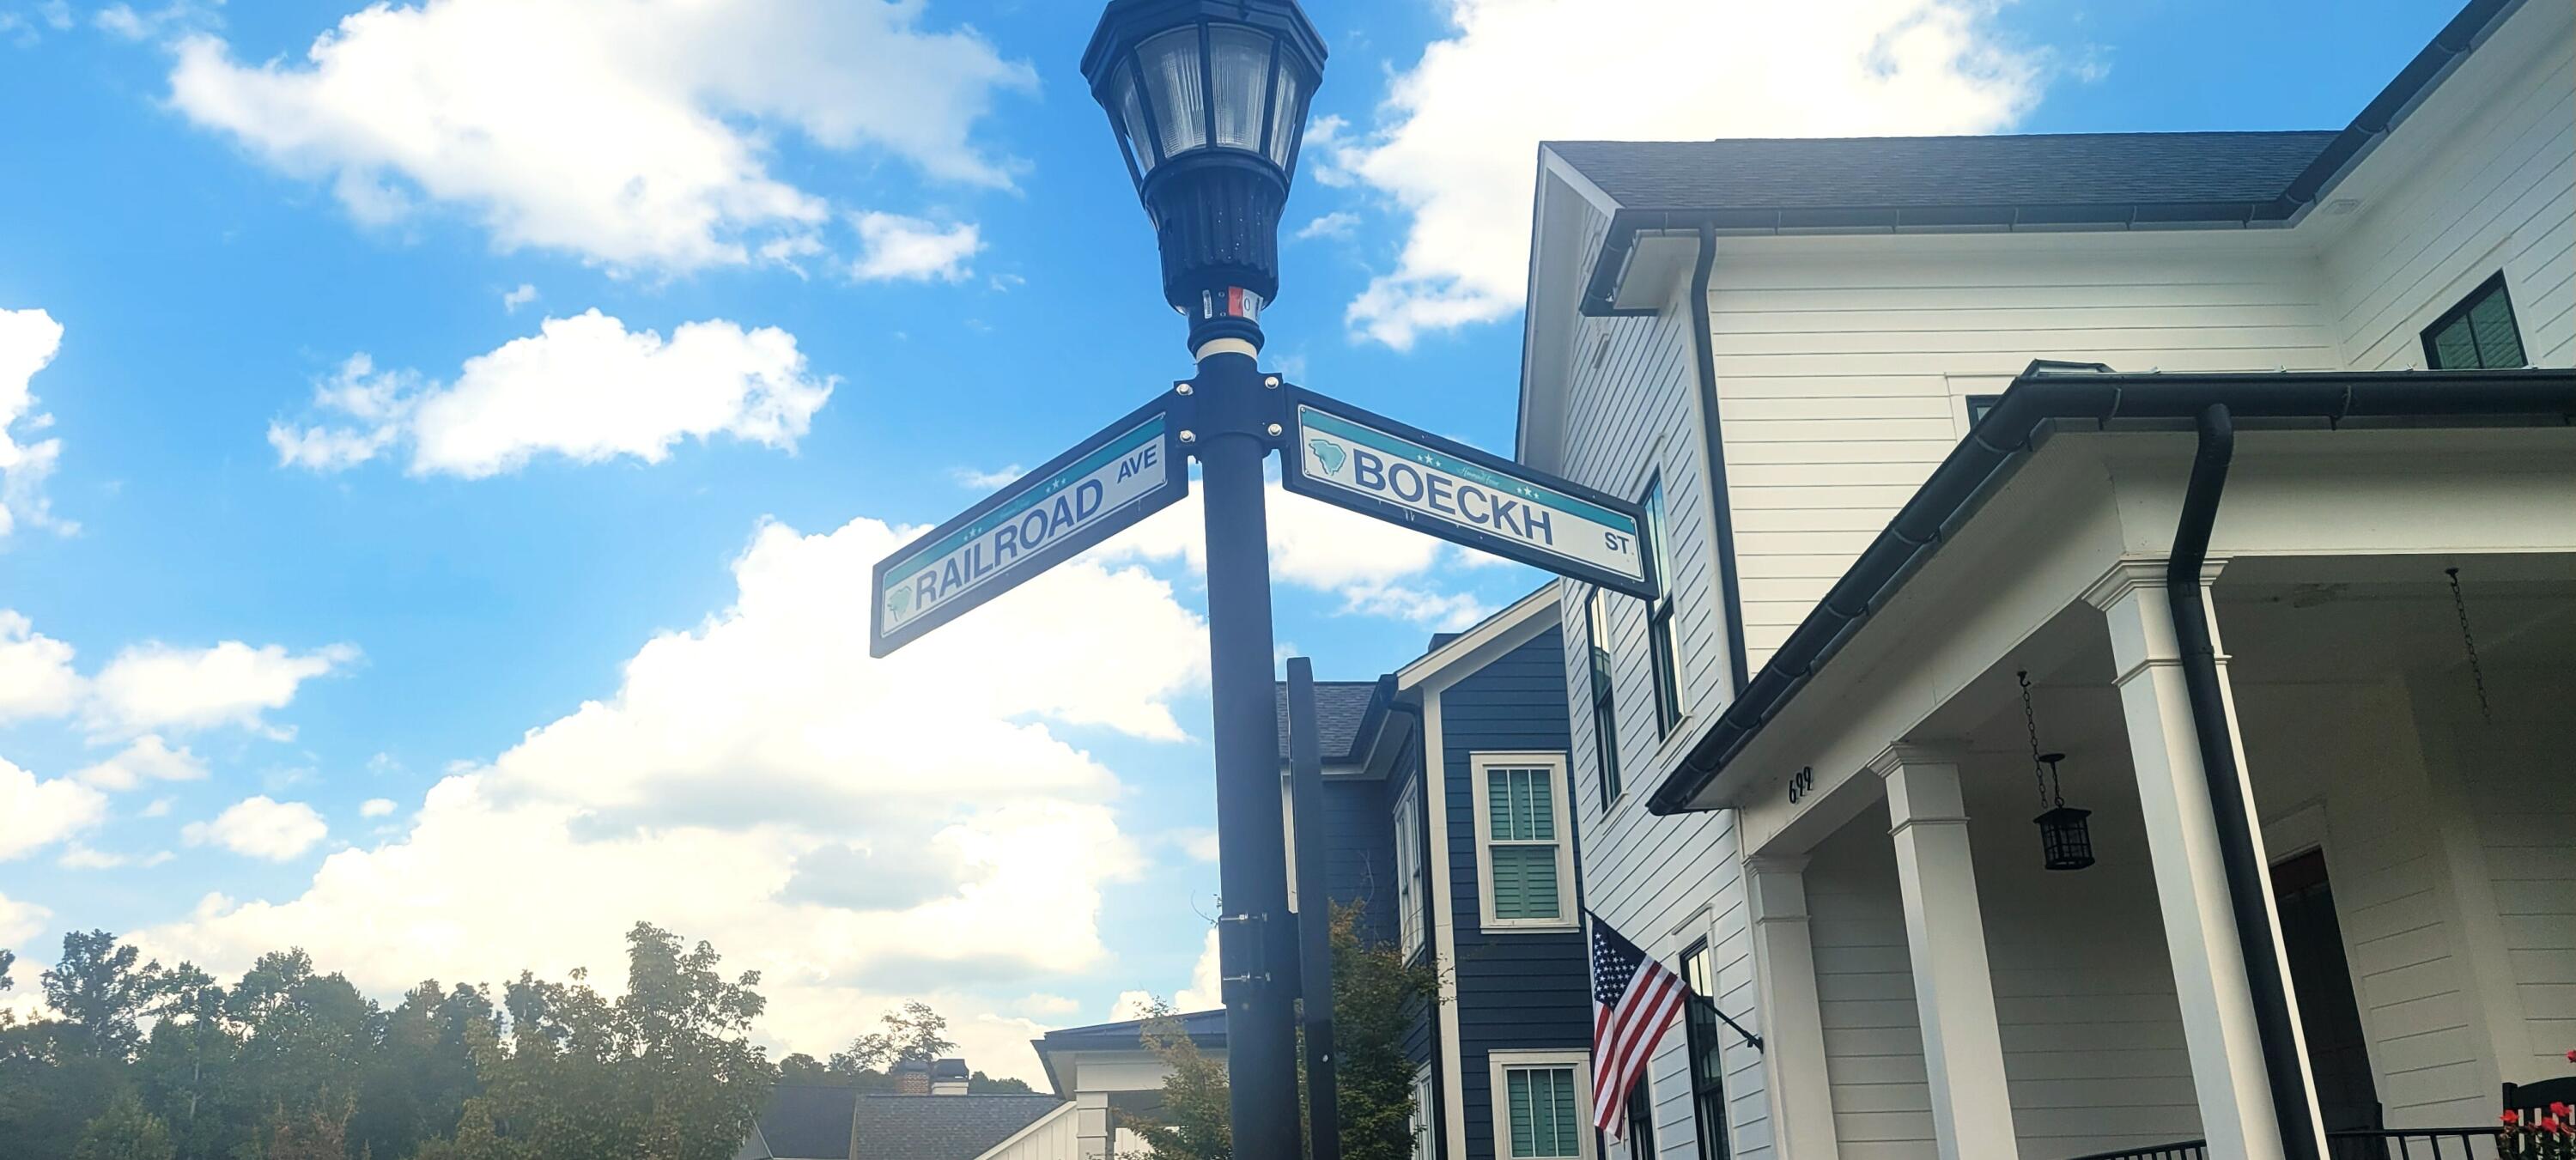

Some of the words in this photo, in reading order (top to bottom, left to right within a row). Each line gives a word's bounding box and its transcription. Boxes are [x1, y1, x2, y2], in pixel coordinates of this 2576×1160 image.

[915, 478, 1103, 610] RAILROAD
[1117, 444, 1157, 484] AVE
[1353, 448, 1553, 545] BOECKH
[1605, 531, 1630, 555] ST
[1789, 766, 1813, 804] 699
